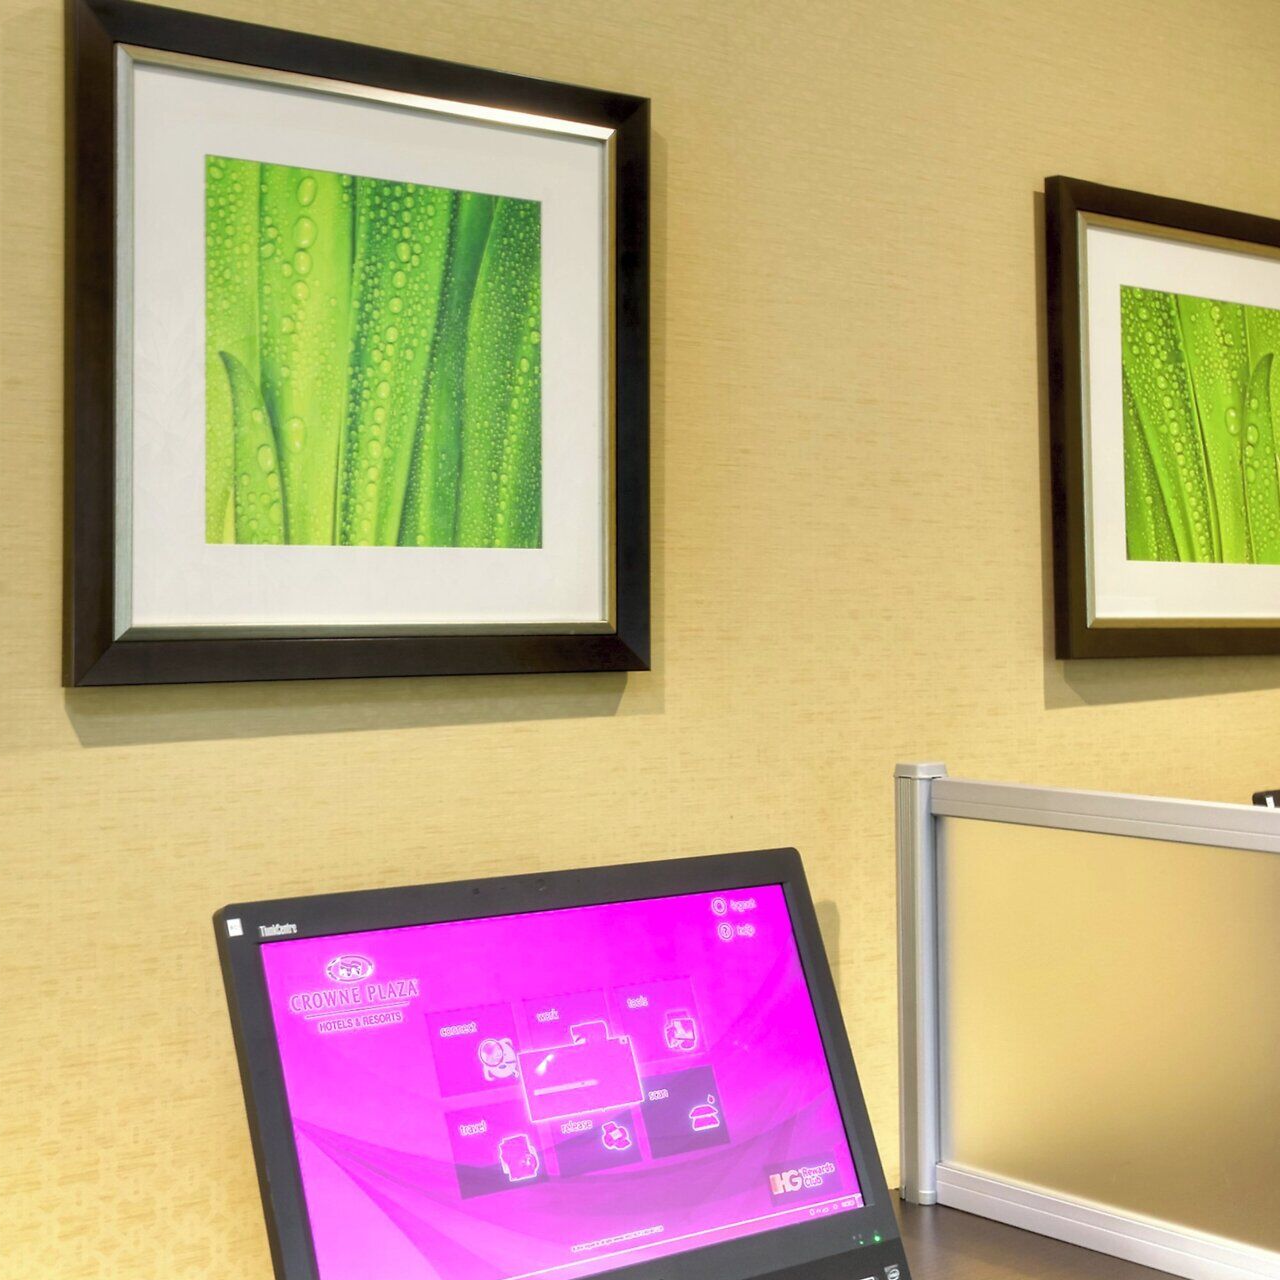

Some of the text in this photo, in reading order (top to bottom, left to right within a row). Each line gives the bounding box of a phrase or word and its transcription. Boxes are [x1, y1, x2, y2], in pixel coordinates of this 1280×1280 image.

[291, 981, 419, 1011] CROWNE PLAZA
[319, 1016, 354, 1032] HOTELS
[363, 1011, 402, 1026] RESORTS
[460, 1121, 487, 1136] travel
[561, 1120, 593, 1134] release
[802, 1162, 835, 1177] Rewards
[803, 1176, 823, 1188] Club
